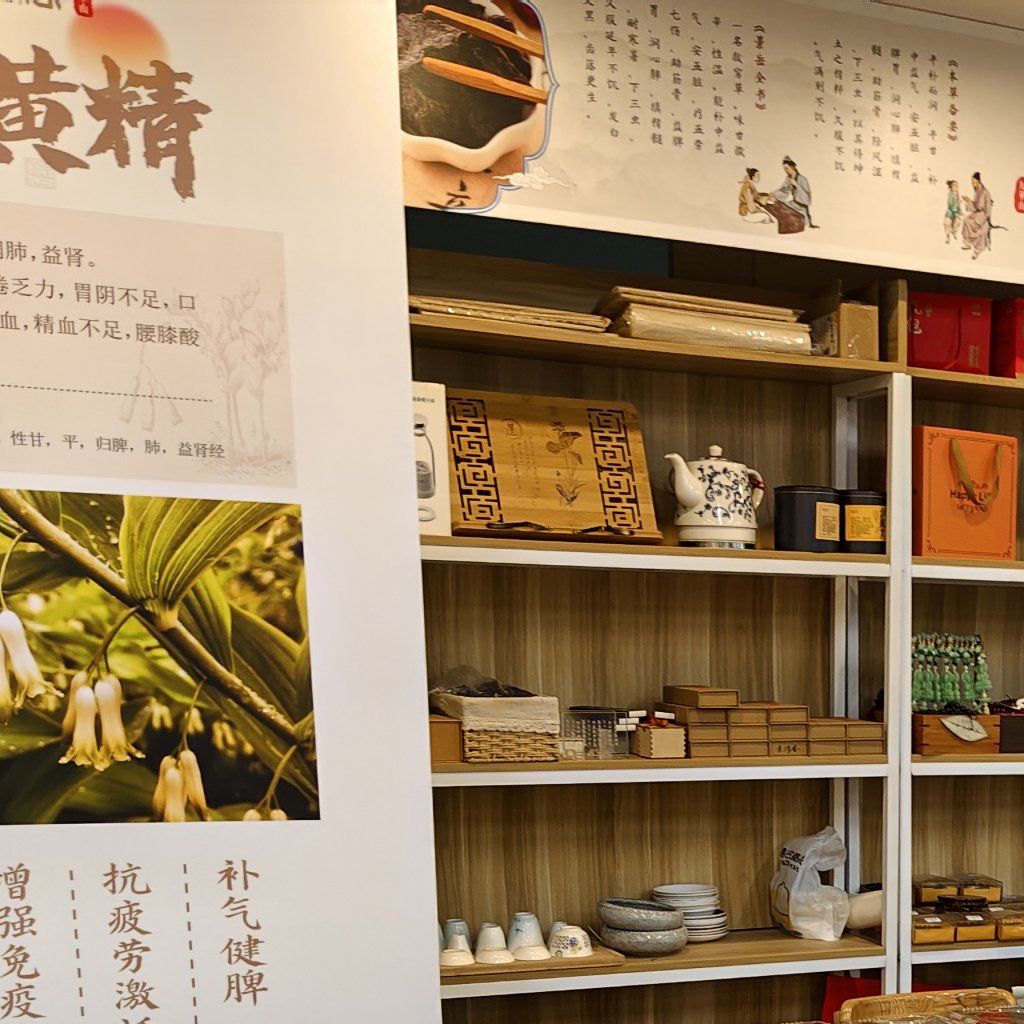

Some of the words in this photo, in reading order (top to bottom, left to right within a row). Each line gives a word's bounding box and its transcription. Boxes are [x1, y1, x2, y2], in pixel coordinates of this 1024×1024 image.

[0, 44, 212, 202] 黄精
[0, 240, 96, 268] 肺，益肾。
[217, 860, 268, 1006] 补气健脾
